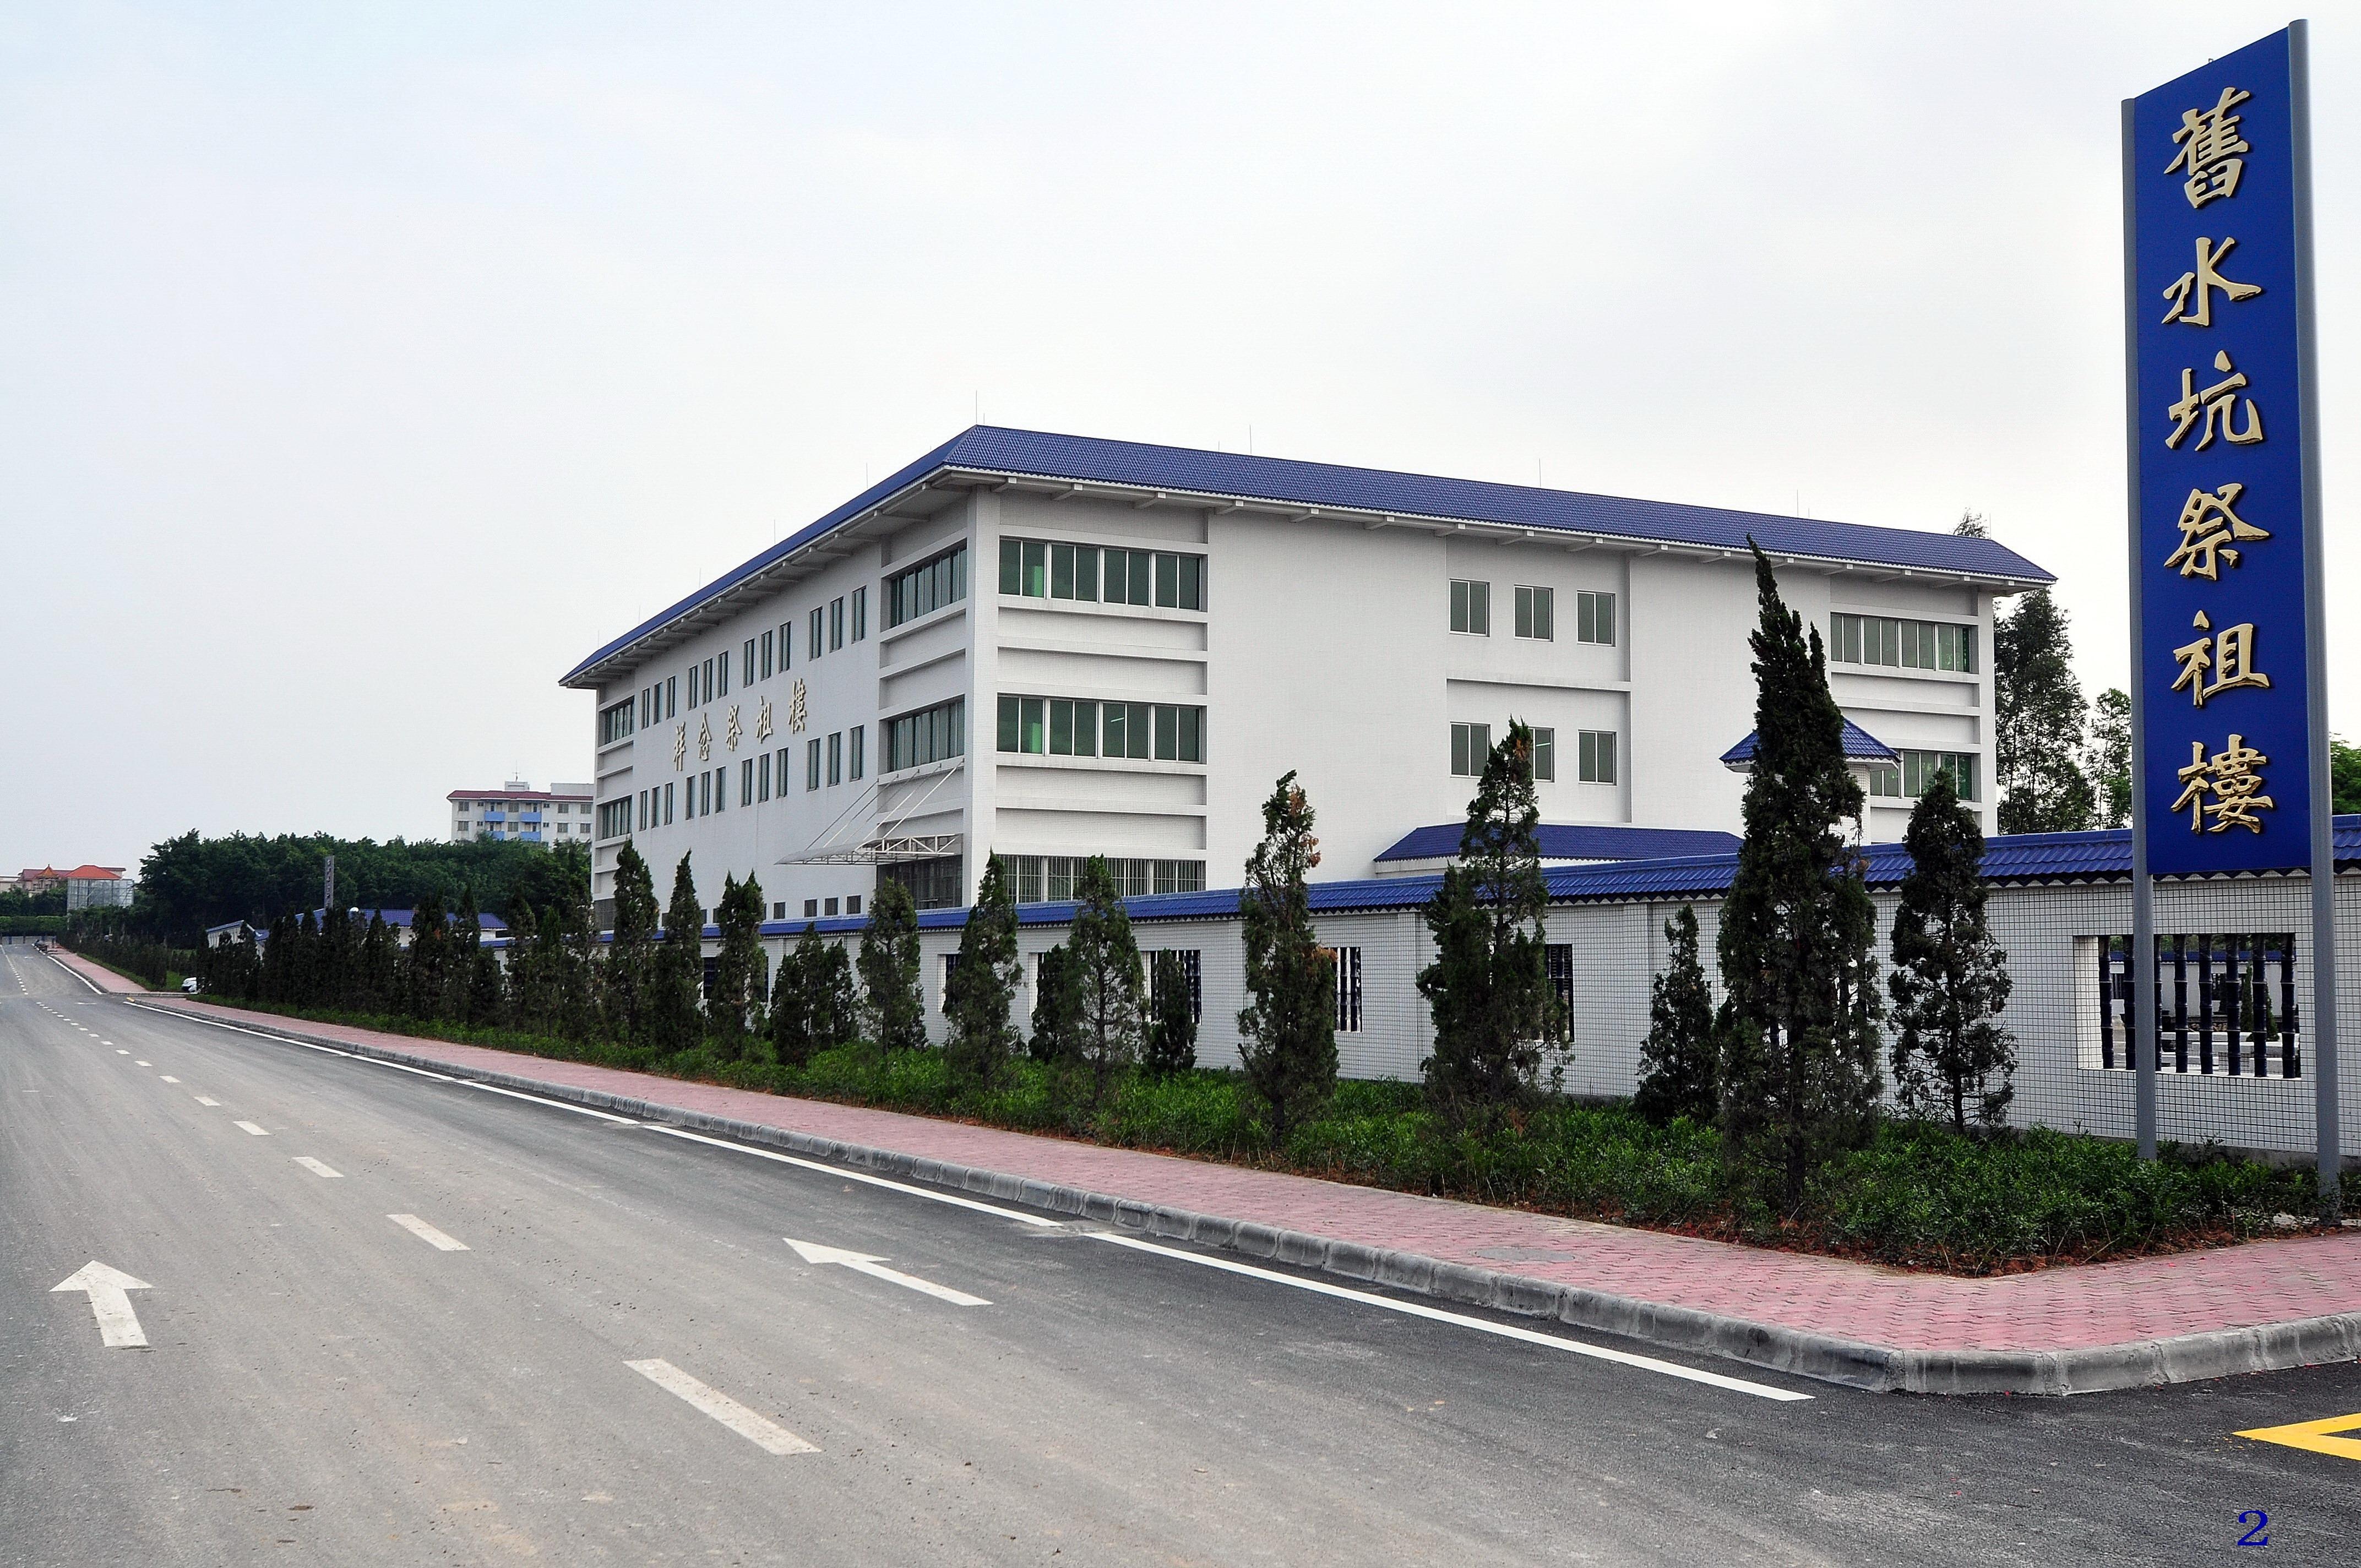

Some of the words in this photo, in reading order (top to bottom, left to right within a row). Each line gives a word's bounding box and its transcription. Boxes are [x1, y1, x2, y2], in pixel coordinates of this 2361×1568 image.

[2162, 86, 2274, 834] 舊水坑祭祖樓
